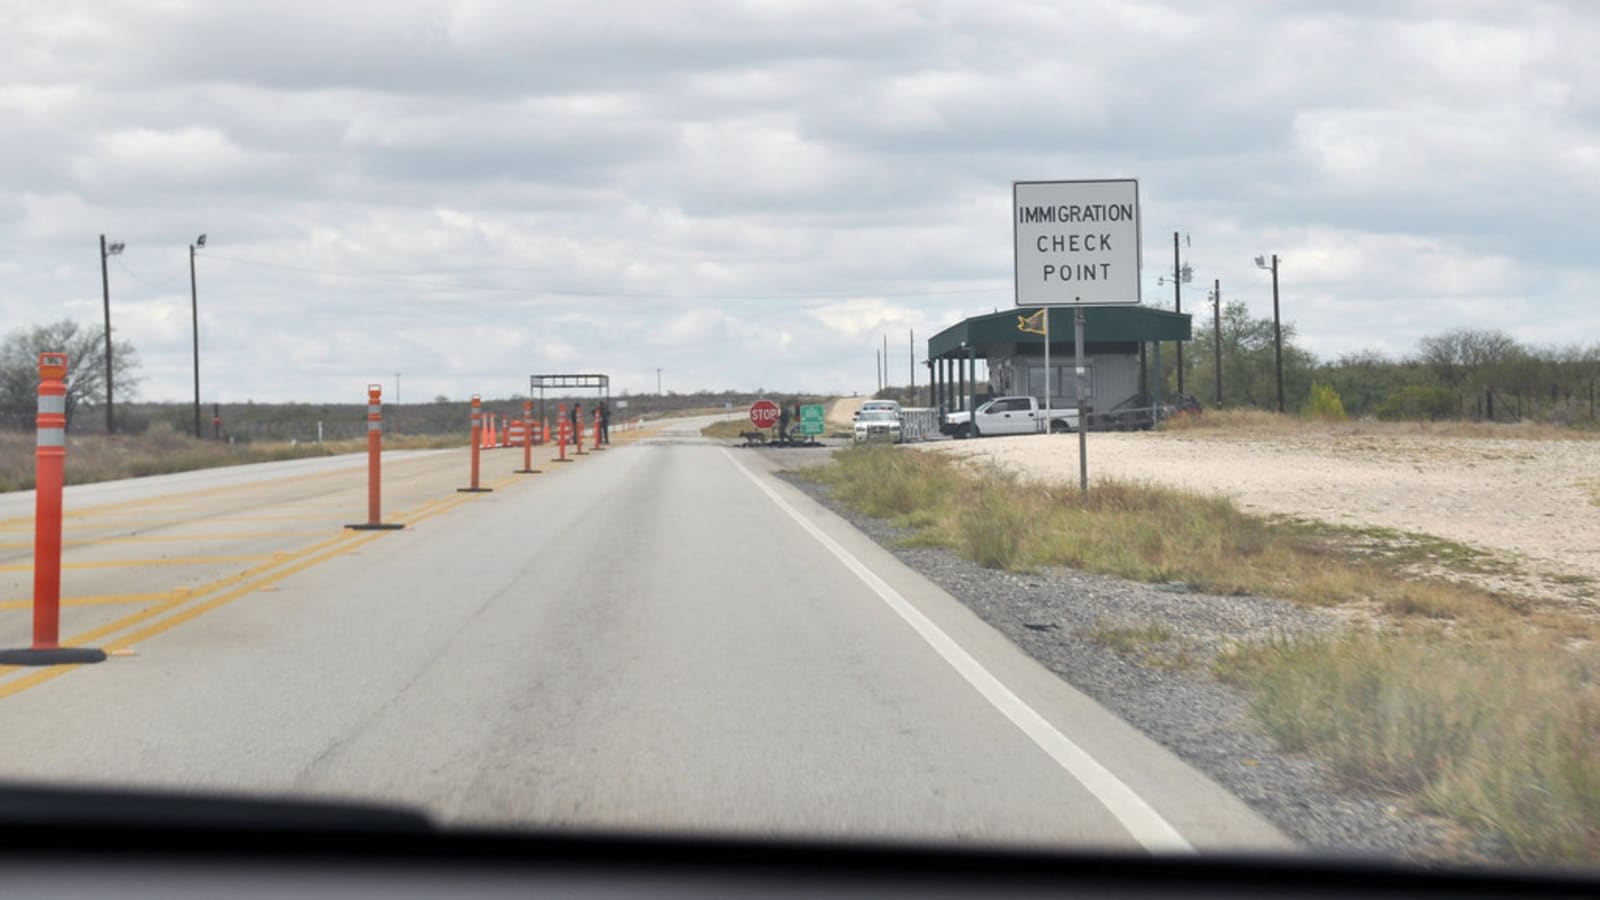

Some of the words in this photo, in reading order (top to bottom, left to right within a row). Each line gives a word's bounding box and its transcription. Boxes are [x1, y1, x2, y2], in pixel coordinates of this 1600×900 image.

[1019, 203, 1133, 223] IMMIGRATION
[1037, 234, 1112, 253] CHECK
[1043, 264, 1111, 282] POINT
[751, 408, 778, 421] STOP
